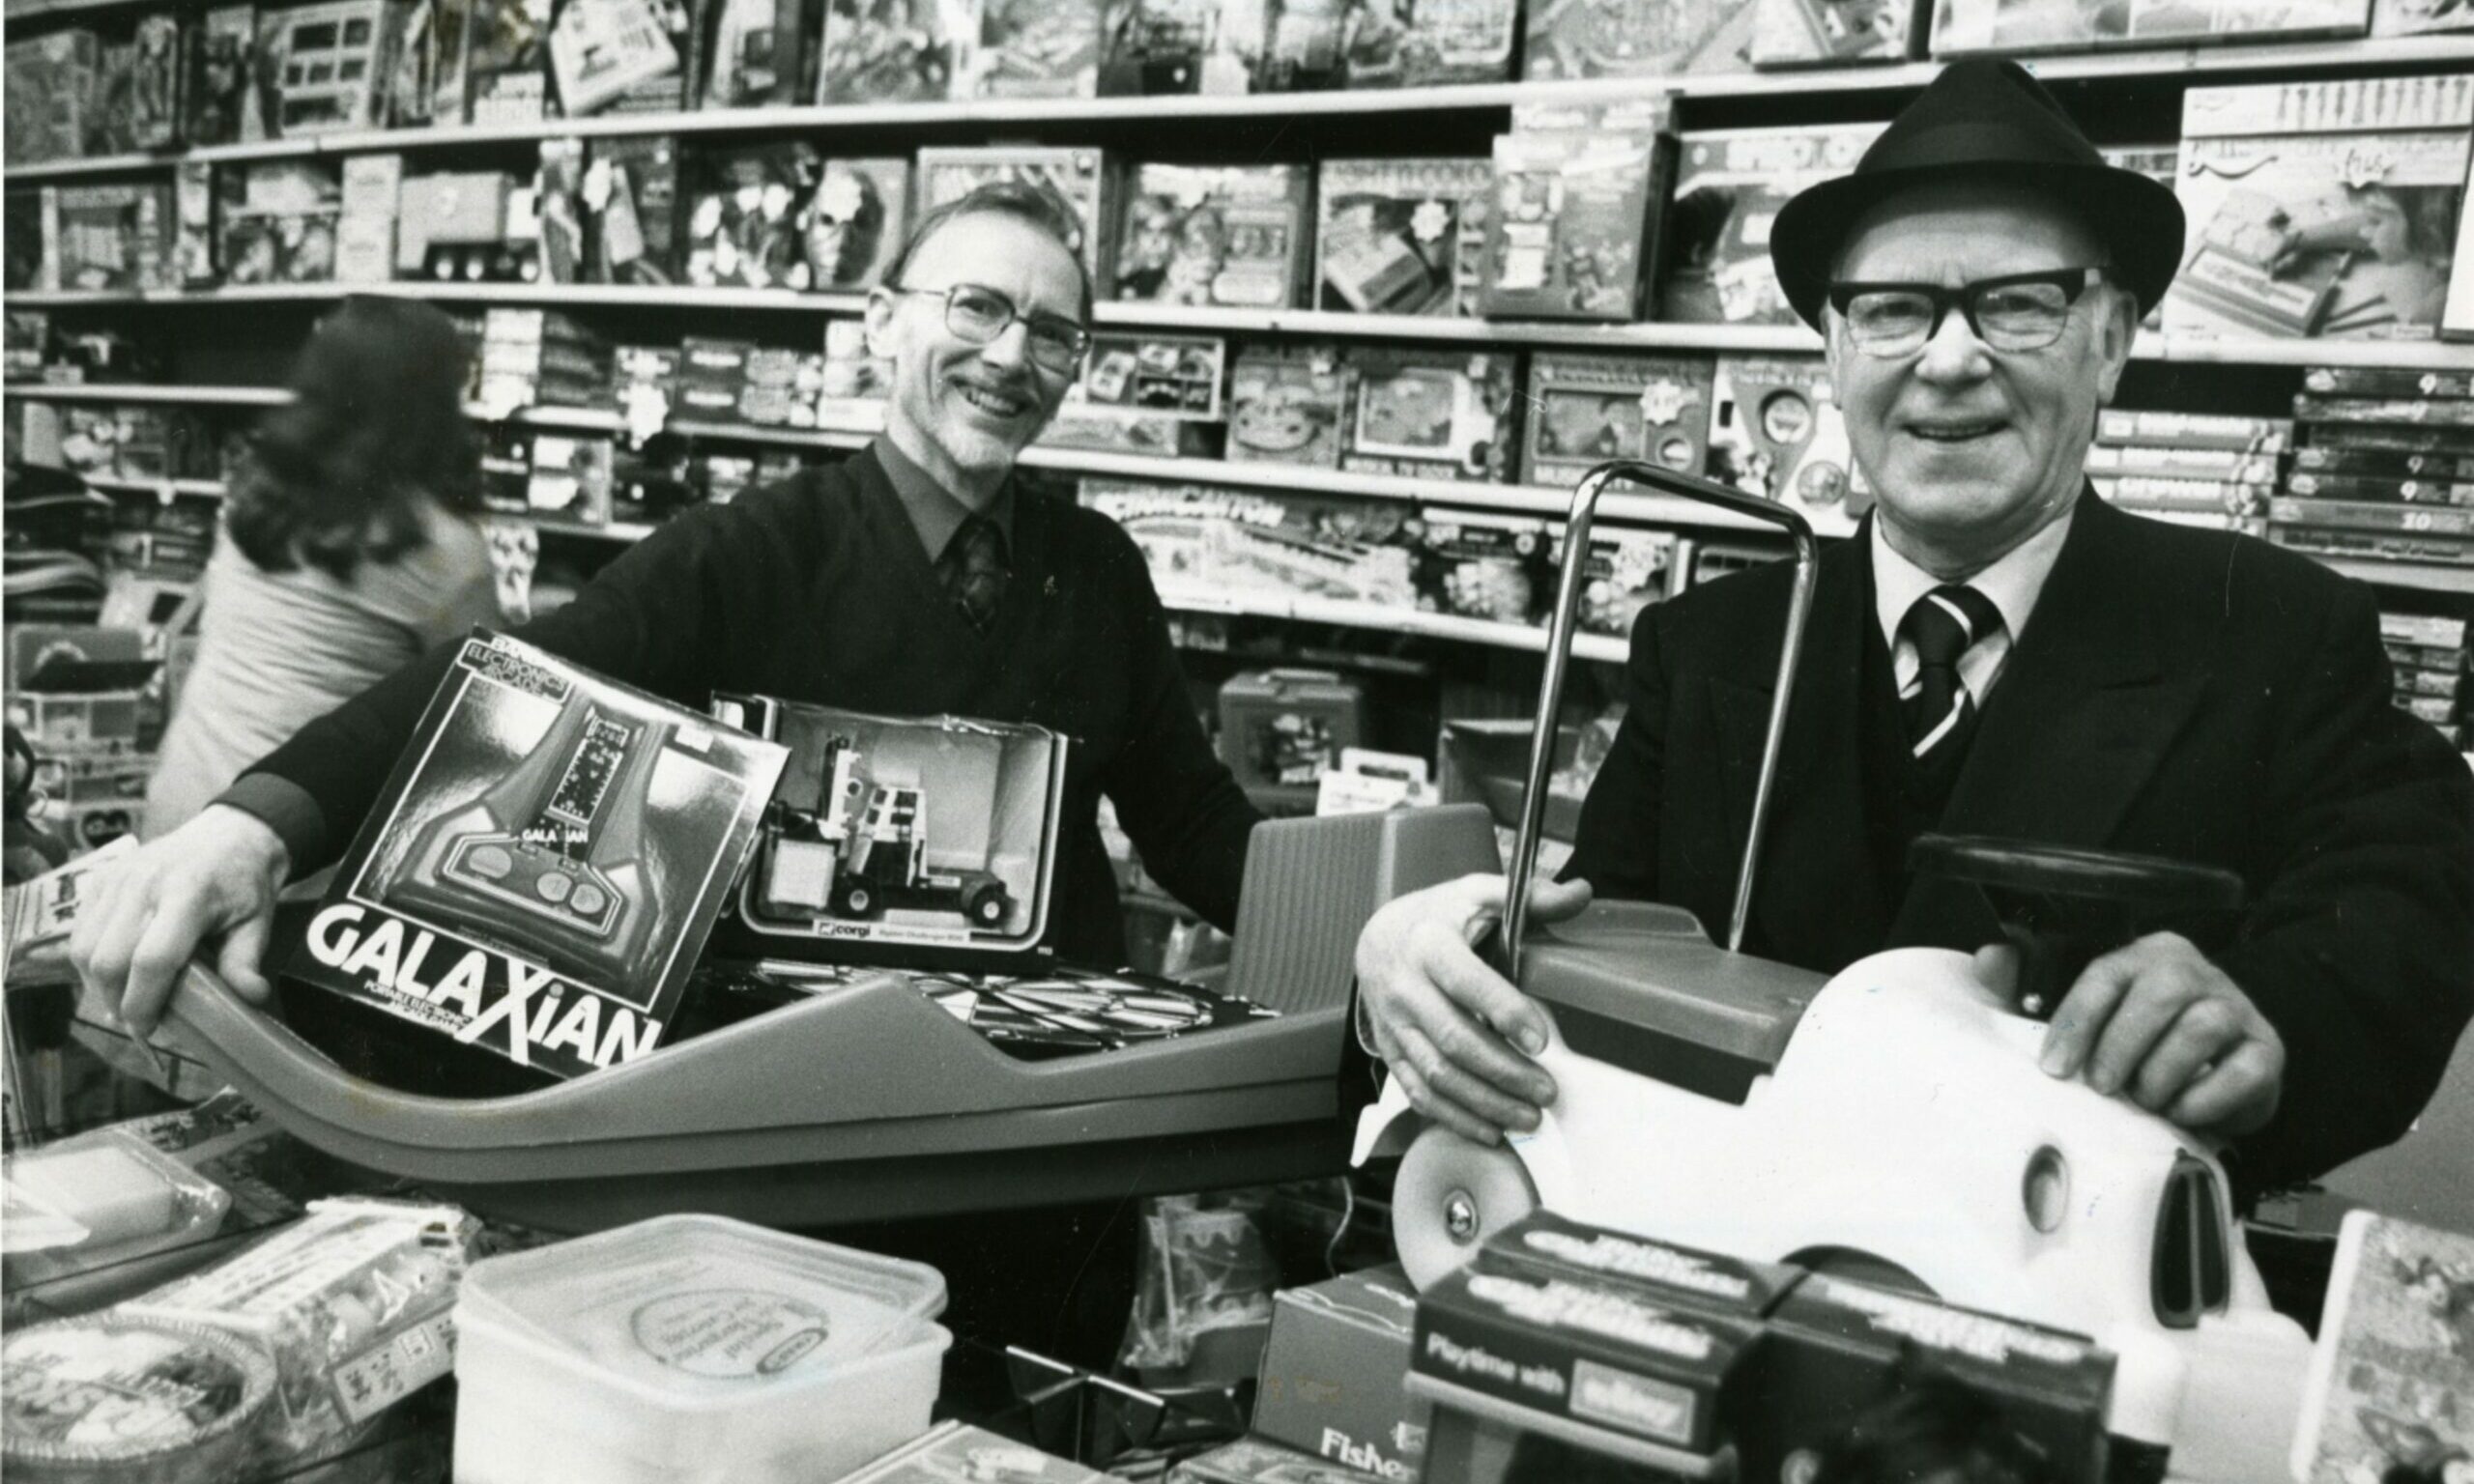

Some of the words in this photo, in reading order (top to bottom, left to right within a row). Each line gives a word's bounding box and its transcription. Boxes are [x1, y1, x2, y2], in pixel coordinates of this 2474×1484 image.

[468, 643, 565, 691] ELECTRONICS
[480, 664, 543, 695] ARCADE
[835, 925, 871, 939] corgi
